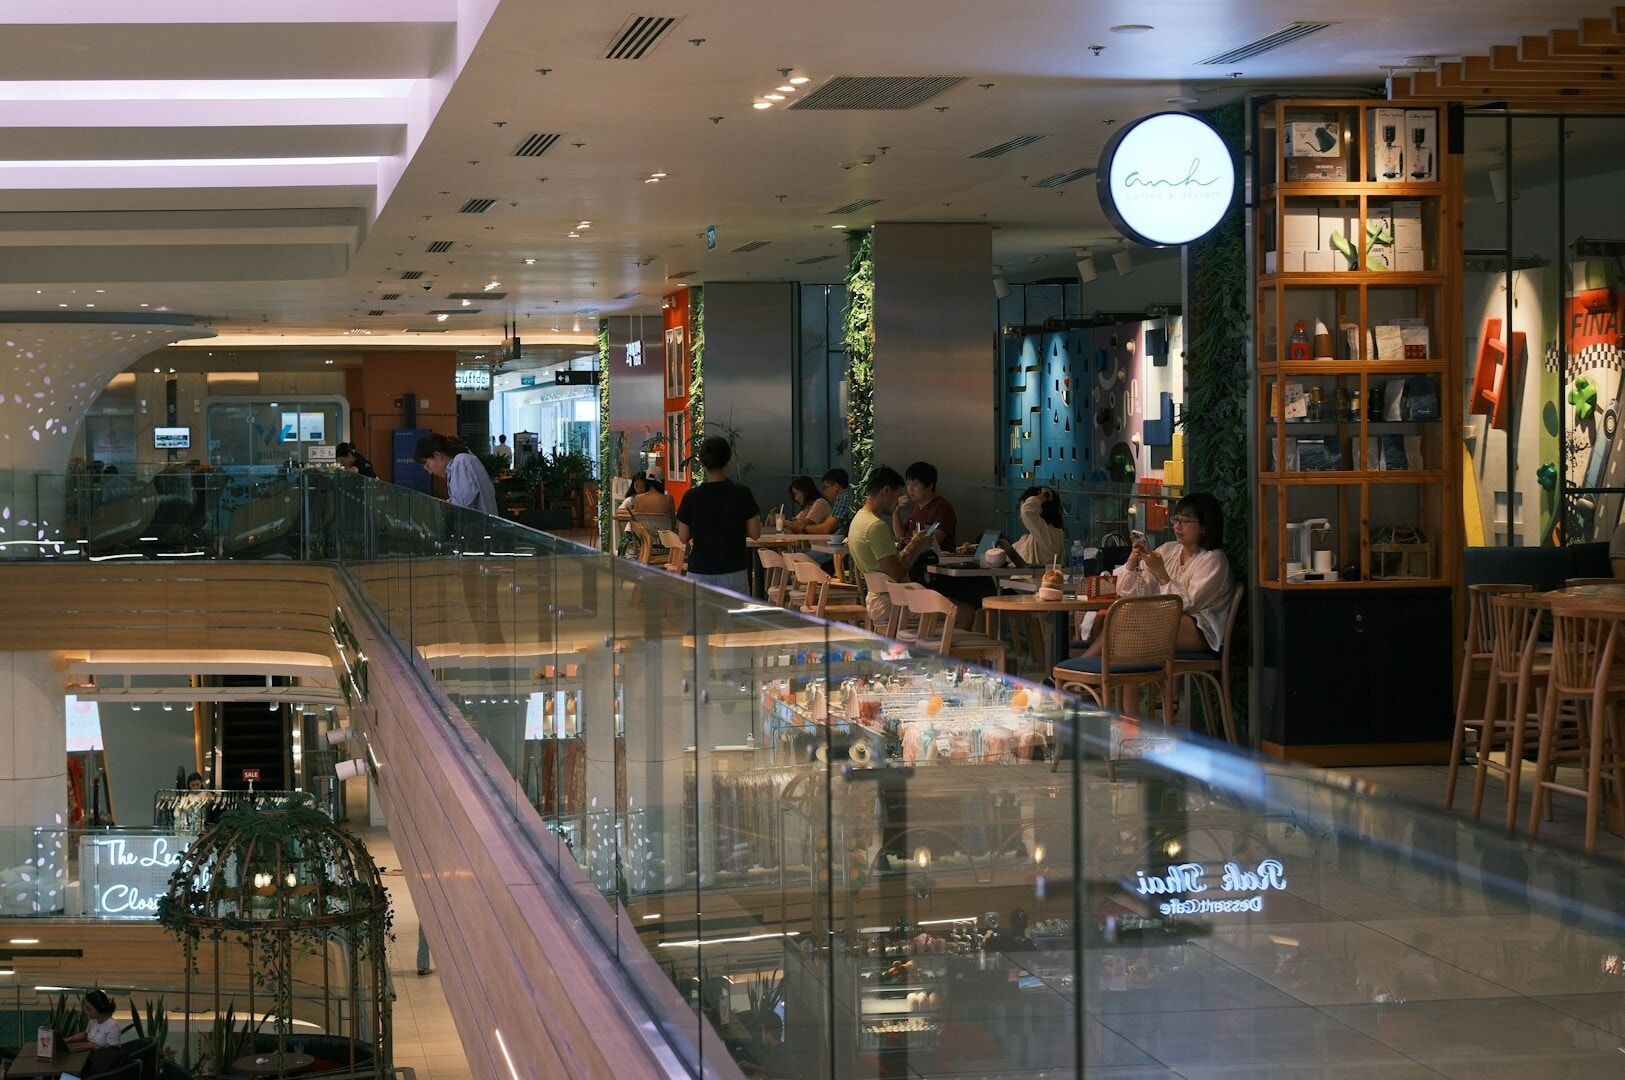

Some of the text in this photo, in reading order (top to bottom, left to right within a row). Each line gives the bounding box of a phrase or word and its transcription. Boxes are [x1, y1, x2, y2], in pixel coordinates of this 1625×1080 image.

[1124, 157, 1221, 188] anh
[1126, 192, 1163, 201] coffee
[1180, 191, 1220, 200] dessert
[1571, 312, 1621, 337] FINA
[97, 839, 138, 866] The
[101, 883, 166, 912] Clos
